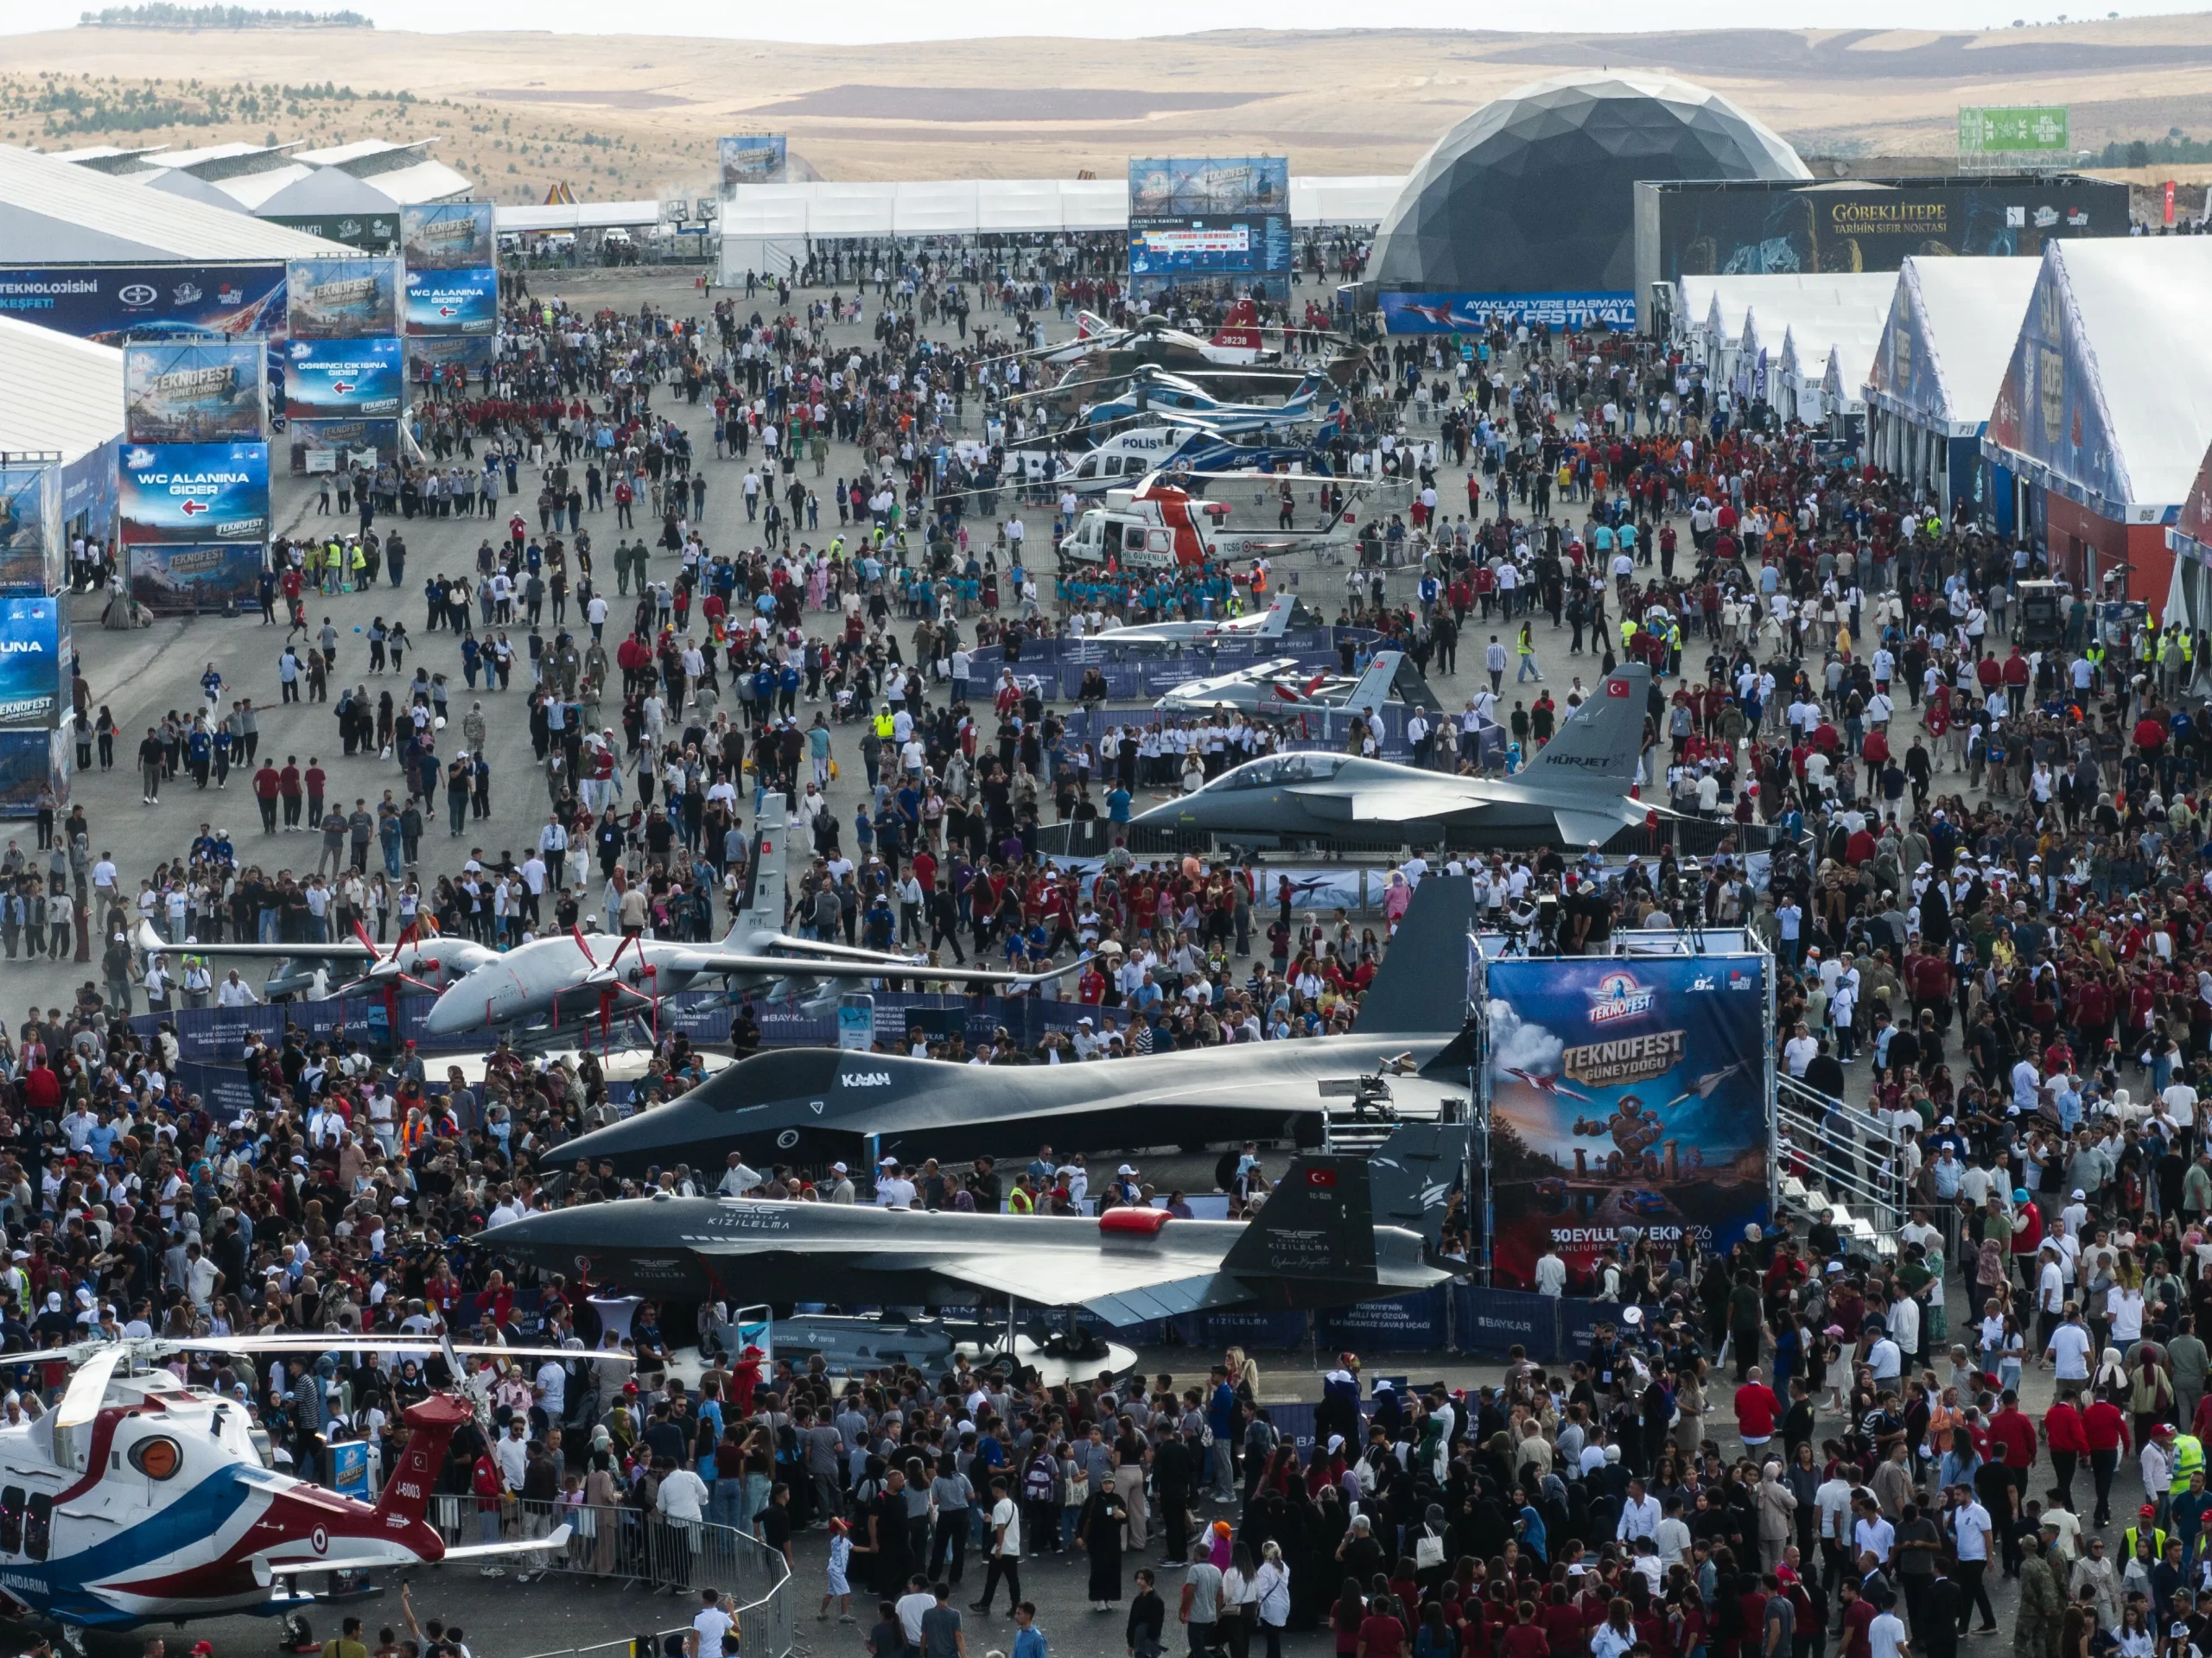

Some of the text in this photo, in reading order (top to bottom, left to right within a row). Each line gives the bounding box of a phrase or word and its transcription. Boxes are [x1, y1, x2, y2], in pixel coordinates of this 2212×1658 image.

[1833, 201, 1947, 222] GÖBEKLİTEPE
[1834, 222, 1947, 234] TARİHİN SIFIR NOKTASI
[0, 279, 98, 294] TEKNOLOJİSİNİ
[313, 277, 375, 297] TEKNOFEST
[0, 298, 54, 311] KEŞFET!
[1465, 298, 1636, 309] AYAKLARI YERE BASMAYA
[151, 364, 235, 390] TEKNOFEST
[362, 398, 398, 410] TEKNOFEST
[1959, 424, 1975, 435] F11
[1122, 437, 1157, 449] POLİS
[137, 473, 249, 484] WC ALANINA
[218, 518, 264, 533] TEKNOFEST
[1224, 543, 1240, 552] TCSG
[169, 548, 226, 564] TEKNOFEST
[1134, 552, 1169, 562] GÜVENLİK
[1546, 753, 1610, 767] HÜRJET
[1590, 994, 1655, 1023] TEKNOFEST
[1564, 1031, 1686, 1069] TEKNOFEST
[1586, 1056, 1667, 1080] GÜNEYDOĞU
[842, 1072, 891, 1087] KAAN
[707, 1217, 790, 1229] KIZILELMA
[1551, 1229, 1571, 1242] 30
[1573, 1228, 1618, 1242] EYLÜL
[1382, 1312, 1409, 1320] ÖZGÜN
[1343, 1318, 1377, 1328] İNSANSIZ
[1379, 1320, 1404, 1330] SAVAŞ
[1486, 1317, 1531, 1332] BAYKAR
[396, 1481, 421, 1499] J-6003
[0, 1572, 50, 1596] JANDARMA
